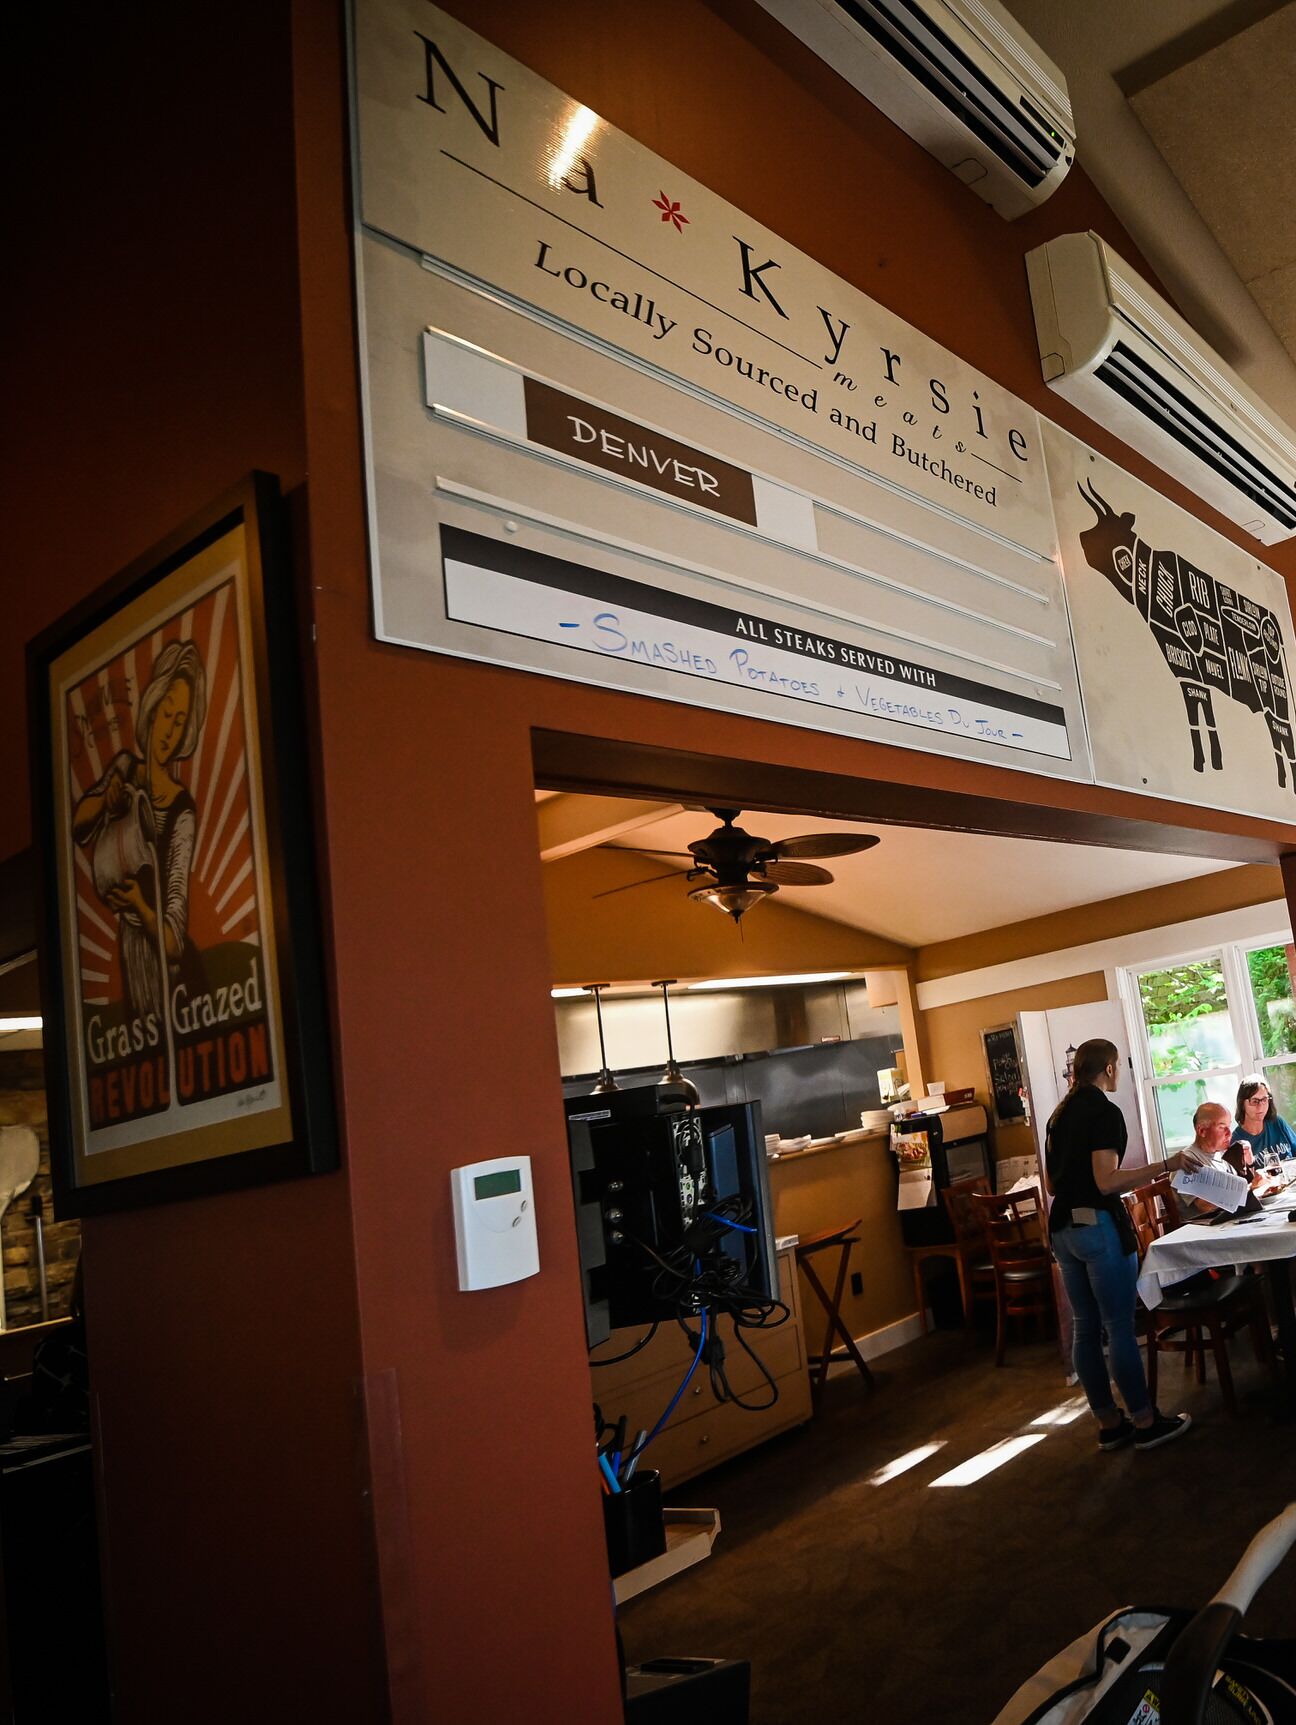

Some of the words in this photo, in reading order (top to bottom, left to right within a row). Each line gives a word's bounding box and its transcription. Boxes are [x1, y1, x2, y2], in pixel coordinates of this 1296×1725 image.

[533, 240, 678, 340] Locally
[692, 328, 818, 414] Sourced
[829, 408, 878, 445] and
[891, 432, 998, 507] Butchered
[732, 235, 1028, 461] Kyrsie
[833, 372, 967, 453] meats
[567, 415, 720, 497] DENVER
[1138, 558, 1147, 595] NECK
[1155, 561, 1175, 618] CHUCK
[1188, 571, 1210, 609] RIB
[735, 617, 768, 641] ALL
[774, 628, 836, 659] STEAKS
[840, 647, 895, 675] SERVED
[899, 663, 936, 687] WITH
[1165, 642, 1193, 671] BRISKET
[1203, 621, 1220, 646] PLATE
[1187, 688, 1208, 702] SHANK
[1205, 658, 1224, 680] NAVEL
[1272, 720, 1290, 738] SHANK
[87, 1012, 160, 1064] Grass
[170, 957, 263, 1035] Grazed
[89, 1023, 270, 1125] REVOLUTION
